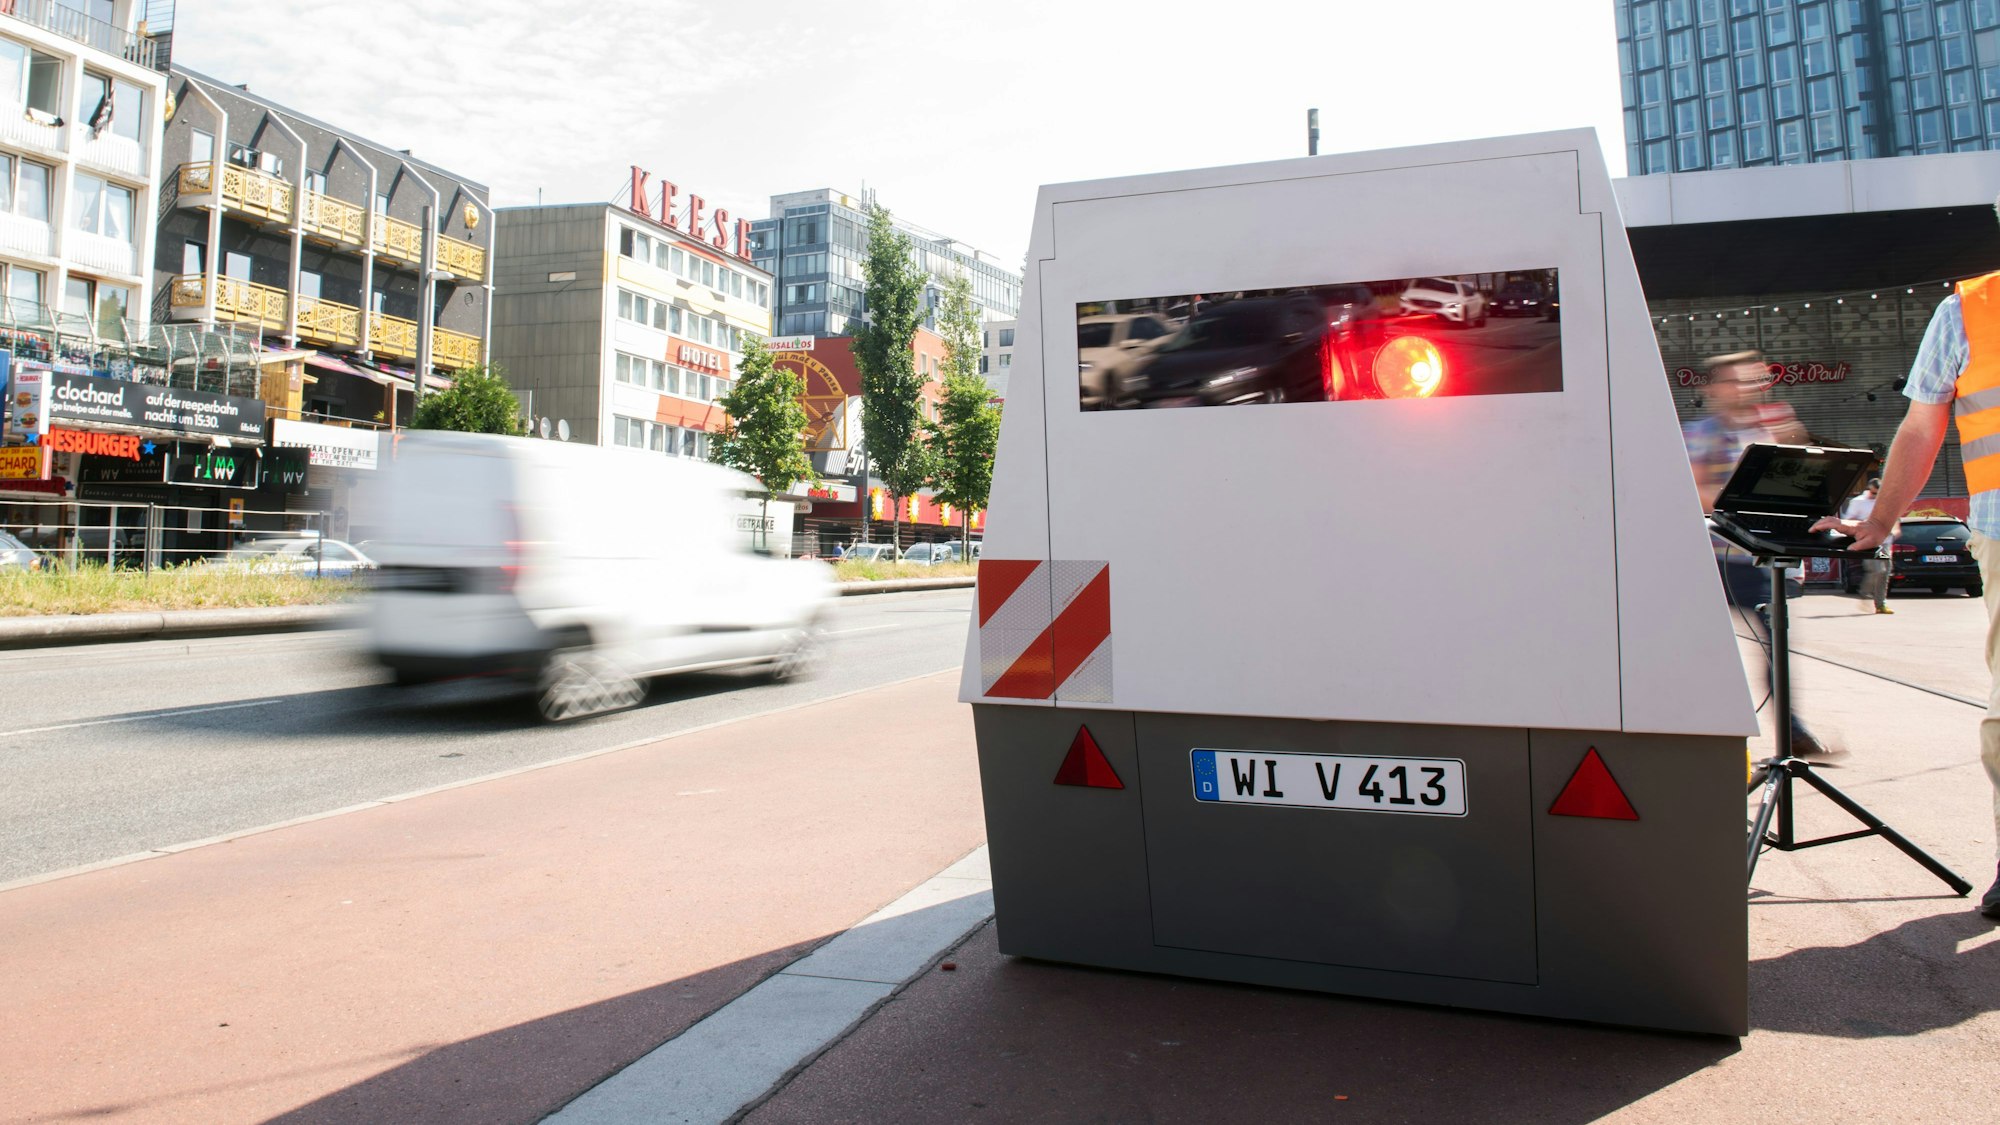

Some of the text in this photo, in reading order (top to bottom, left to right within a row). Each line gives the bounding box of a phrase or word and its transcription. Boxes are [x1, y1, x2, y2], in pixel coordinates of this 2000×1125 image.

[631, 165, 753, 261] KEESE
[680, 345, 722, 371] HOTEL
[1677, 369, 1707, 386] Das
[1807, 363, 1847, 382] Pauli
[57, 380, 124, 406] clochard
[146, 393, 239, 416] auf der reeperbahn
[63, 401, 88, 414] kneipe
[144, 409, 177, 423] nachts
[178, 415, 193, 425] um
[41, 425, 141, 462] HESBURGER
[332, 446, 353, 456] OPEN
[1203, 758, 1447, 806] D WI V 413
